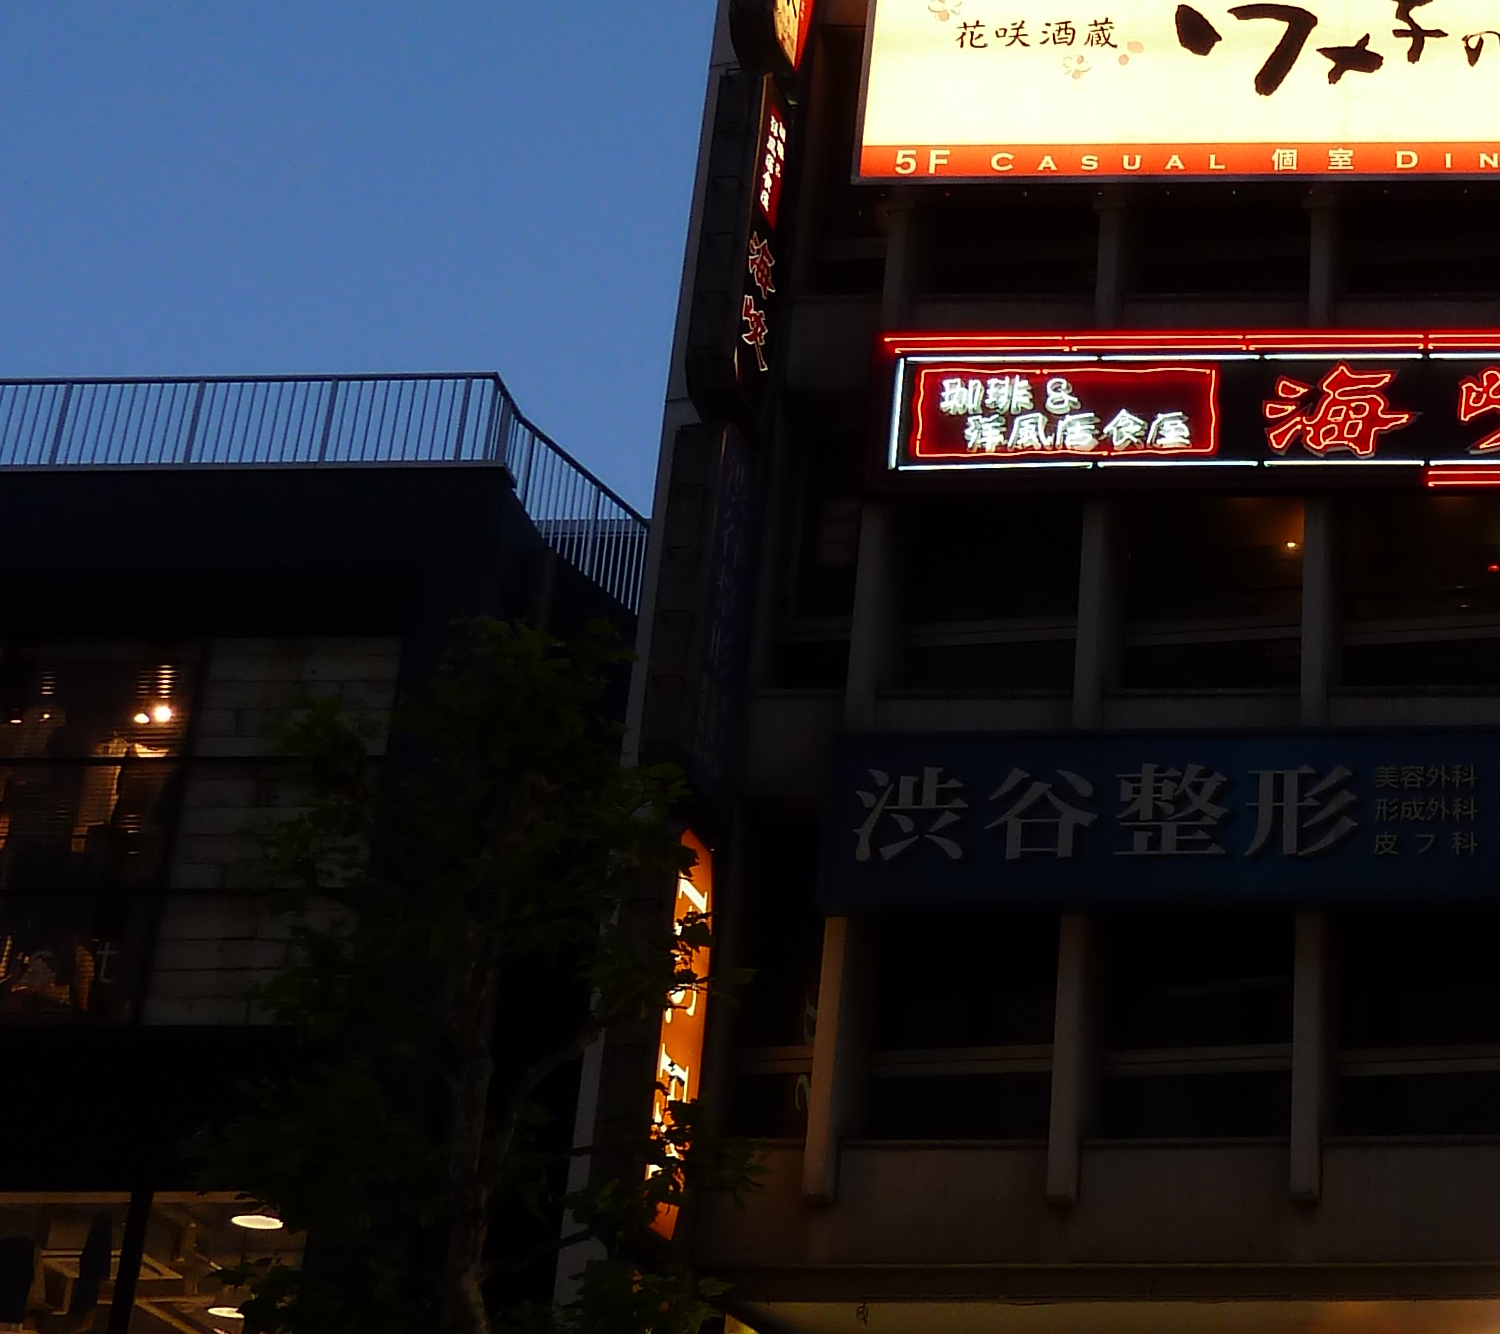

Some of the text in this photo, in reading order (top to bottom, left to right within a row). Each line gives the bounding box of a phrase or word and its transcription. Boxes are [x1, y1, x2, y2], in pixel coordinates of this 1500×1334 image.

[954, 17, 1120, 51] 花咲酒蔵
[893, 148, 954, 177] 5F
[1271, 147, 1356, 173] 個室
[939, 374, 1081, 415] 珈琲 &
[1374, 763, 1479, 790] 美容外科
[850, 761, 1364, 863] 渋谷整形
[1374, 797, 1479, 824] 形成外科
[1374, 829, 1480, 858] 皮フ科
